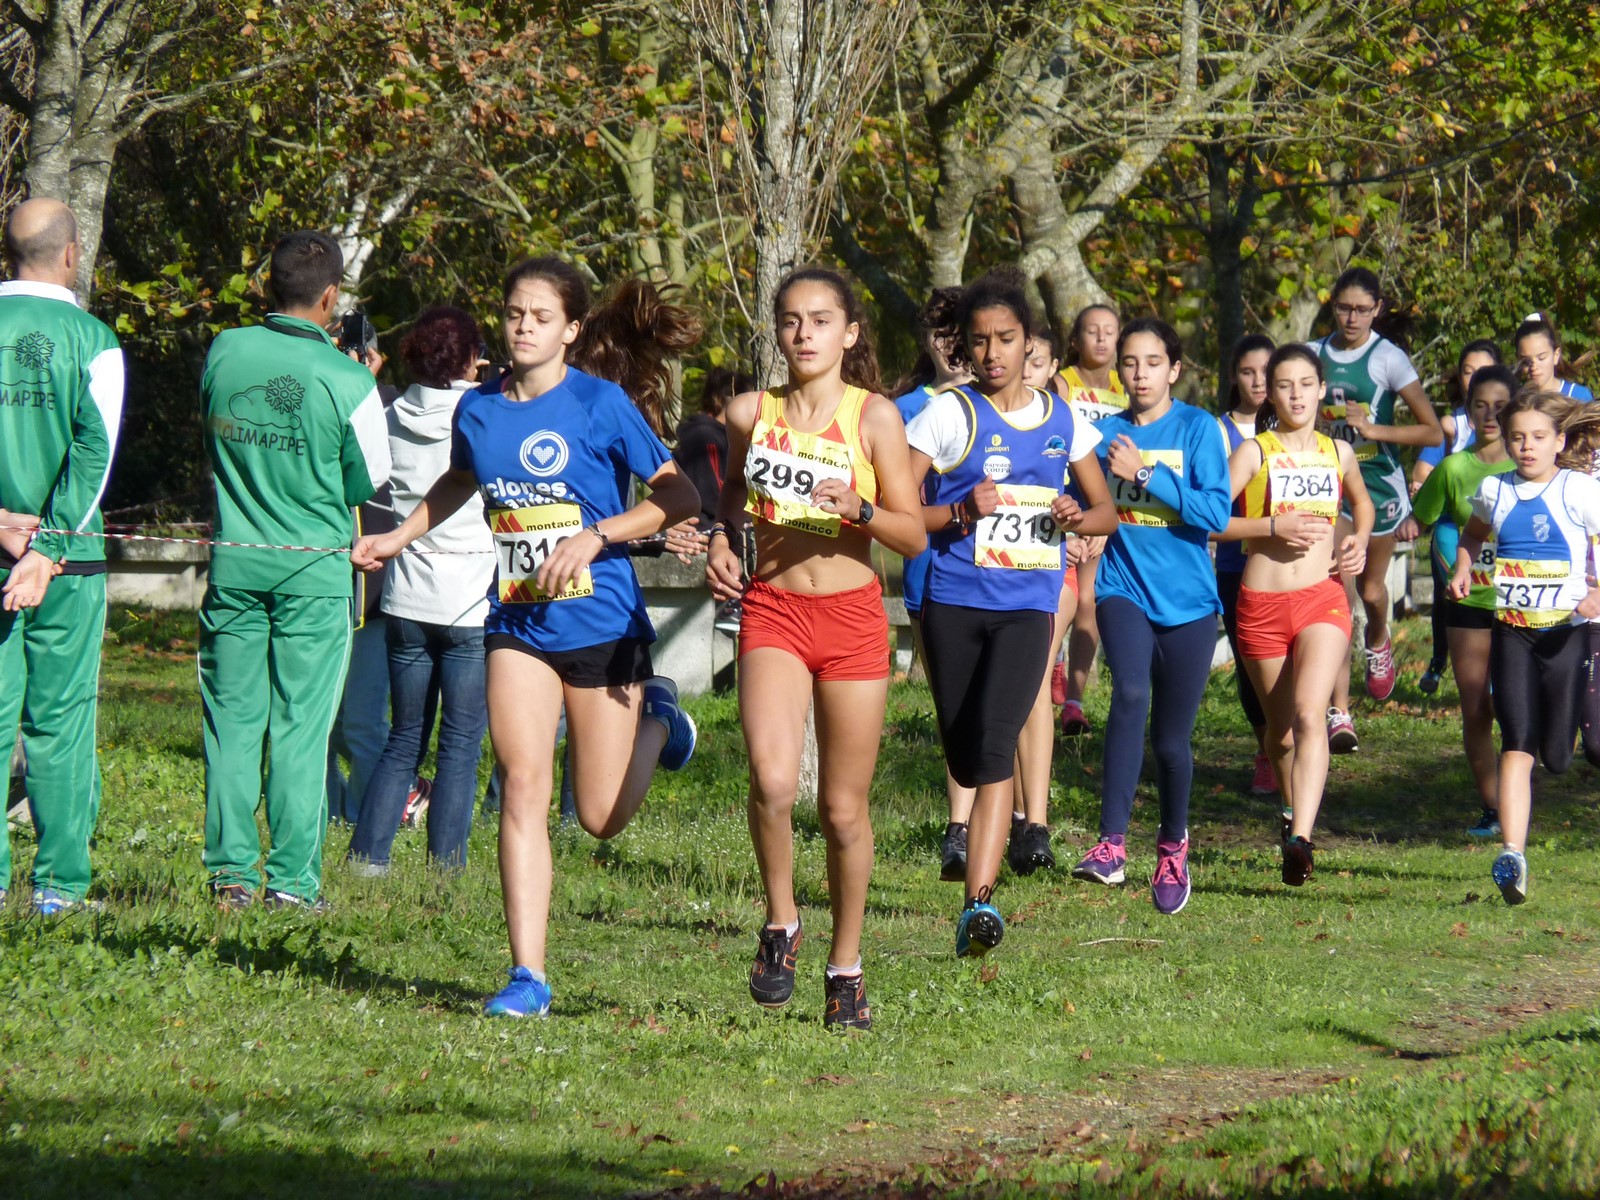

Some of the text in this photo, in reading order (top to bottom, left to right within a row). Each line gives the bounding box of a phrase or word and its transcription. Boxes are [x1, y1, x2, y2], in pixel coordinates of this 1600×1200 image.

[222, 423, 306, 456] CLIMAPIPE
[797, 451, 848, 470] montaco
[751, 457, 814, 496] 299
[1278, 473, 1334, 498] 7364
[526, 518, 580, 532] montaco
[781, 517, 833, 535] montaco
[988, 512, 1056, 545] 7319
[1140, 519, 1183, 527] montaco
[501, 535, 570, 574] 731
[1500, 583, 1564, 608] 7377
[1530, 617, 1571, 628] montaco
